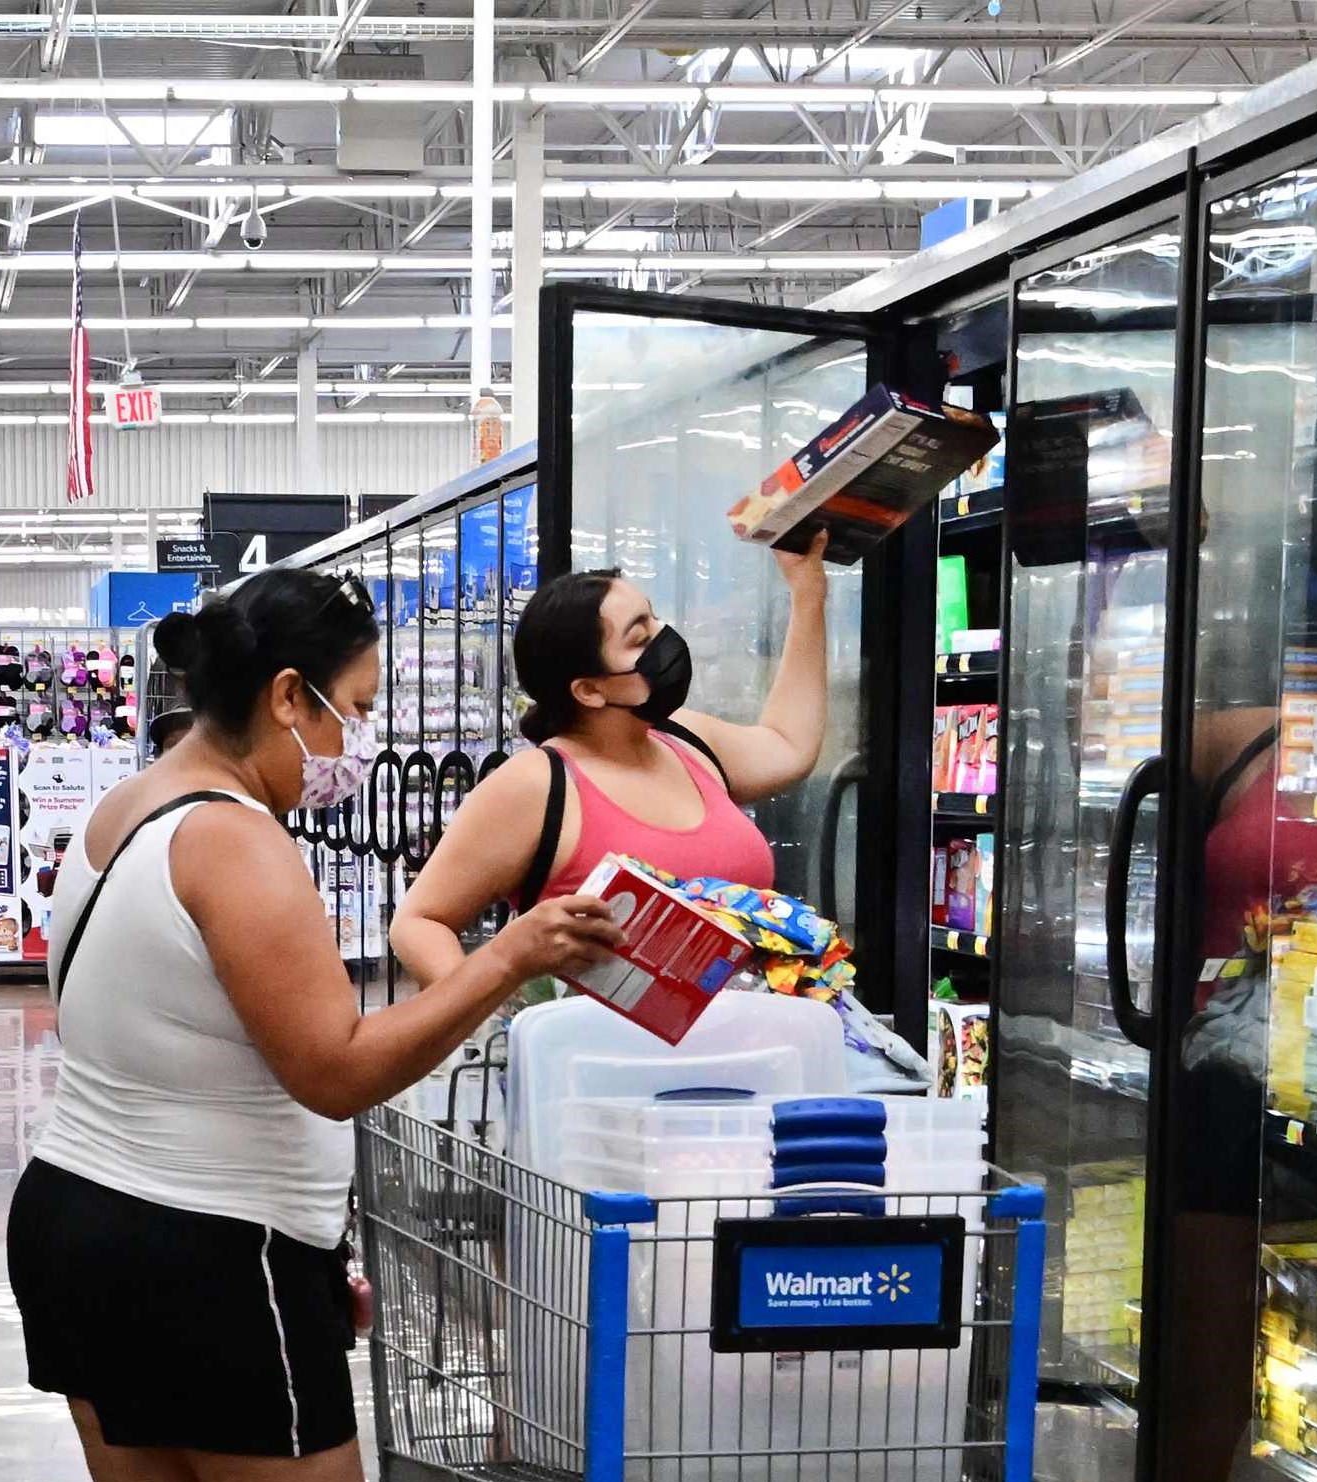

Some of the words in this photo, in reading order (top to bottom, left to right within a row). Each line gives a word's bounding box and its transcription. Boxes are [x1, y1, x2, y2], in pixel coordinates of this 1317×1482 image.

[116, 391, 154, 423] EXIT
[172, 544, 198, 553] Snacks
[199, 544, 206, 552] &
[240, 534, 271, 573] 4
[167, 554, 211, 564] Entertaining
[61, 784, 85, 792] Salute
[59, 803, 77, 811] Pack
[766, 1271, 873, 1296] Walmart
[767, 1298, 788, 1307] Save
[789, 1299, 821, 1308] money.
[823, 1298, 840, 1307] Live
[842, 1297, 873, 1306] better.
